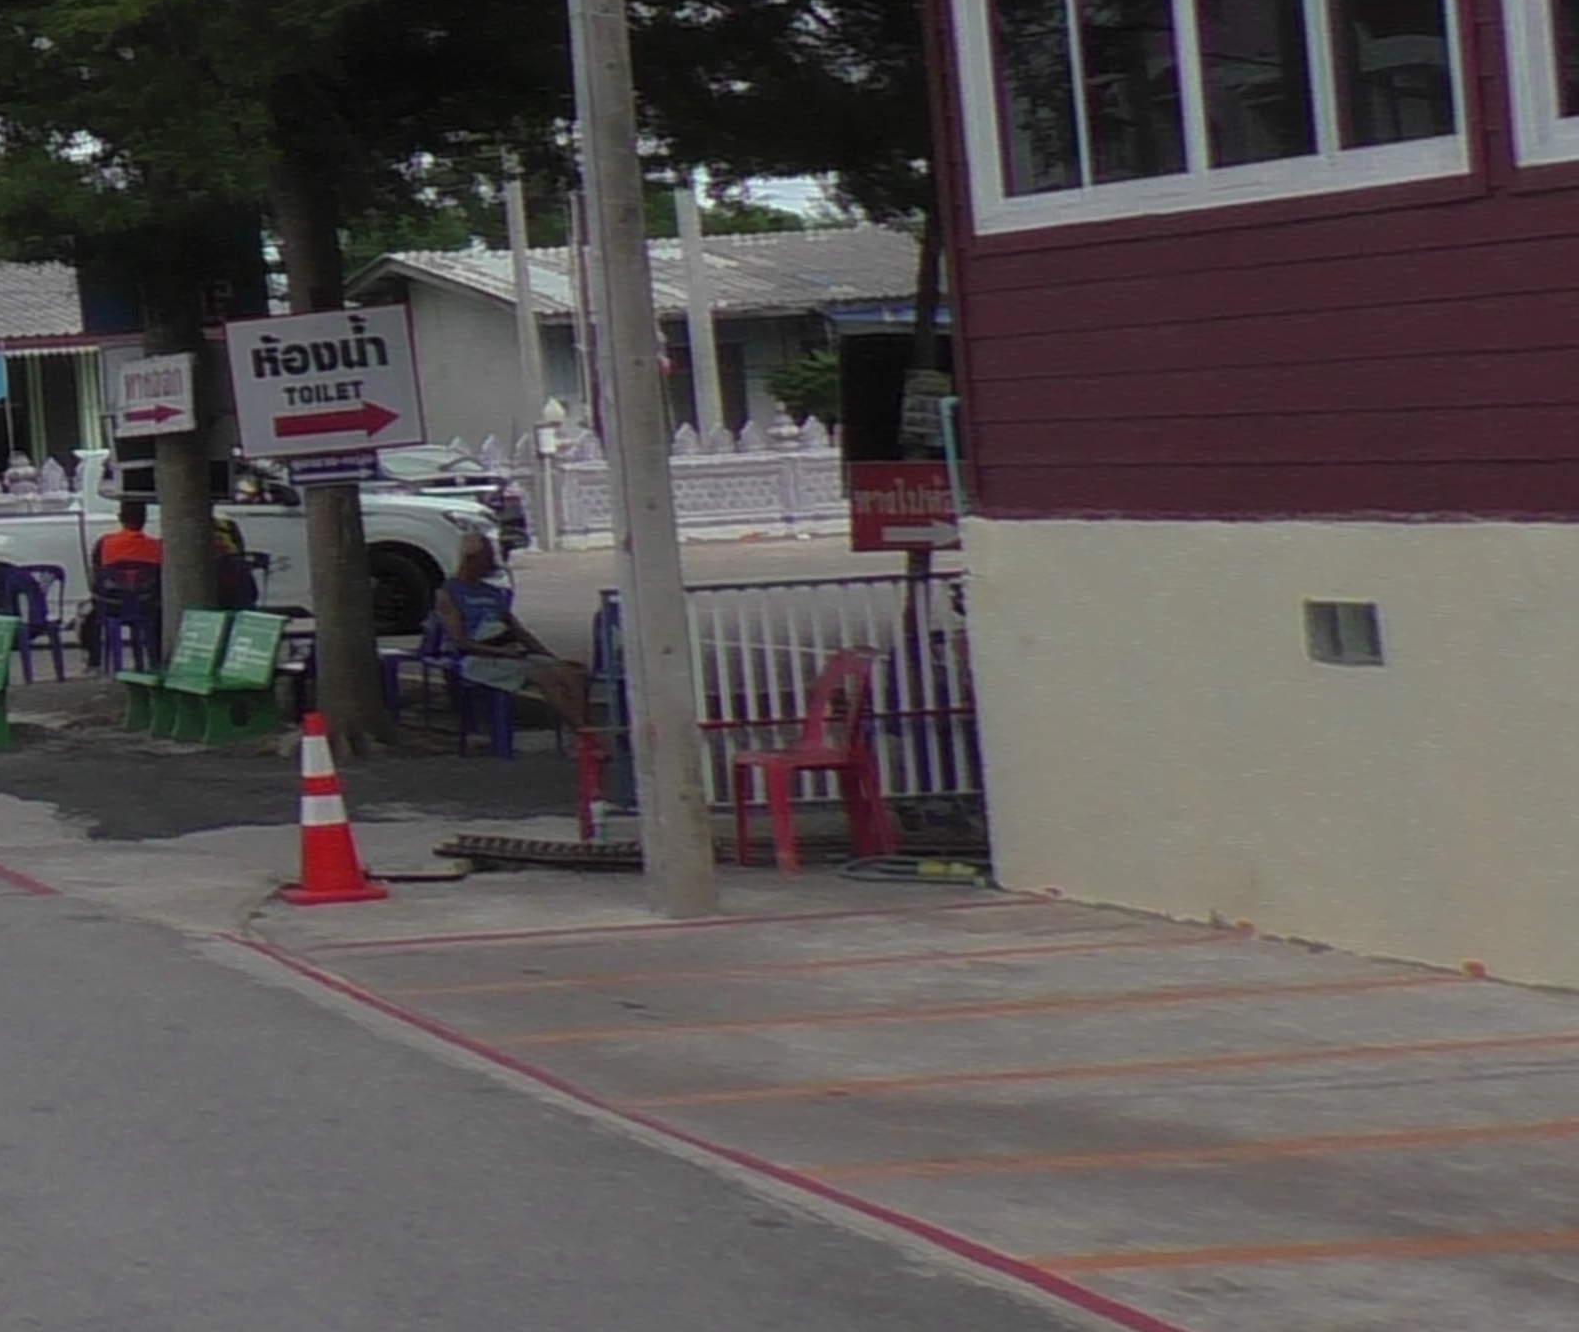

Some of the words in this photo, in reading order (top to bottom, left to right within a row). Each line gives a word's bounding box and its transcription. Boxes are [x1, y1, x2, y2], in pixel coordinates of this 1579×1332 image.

[251, 315, 389, 379] ห้องน้ำ
[284, 380, 364, 406] TOILET
